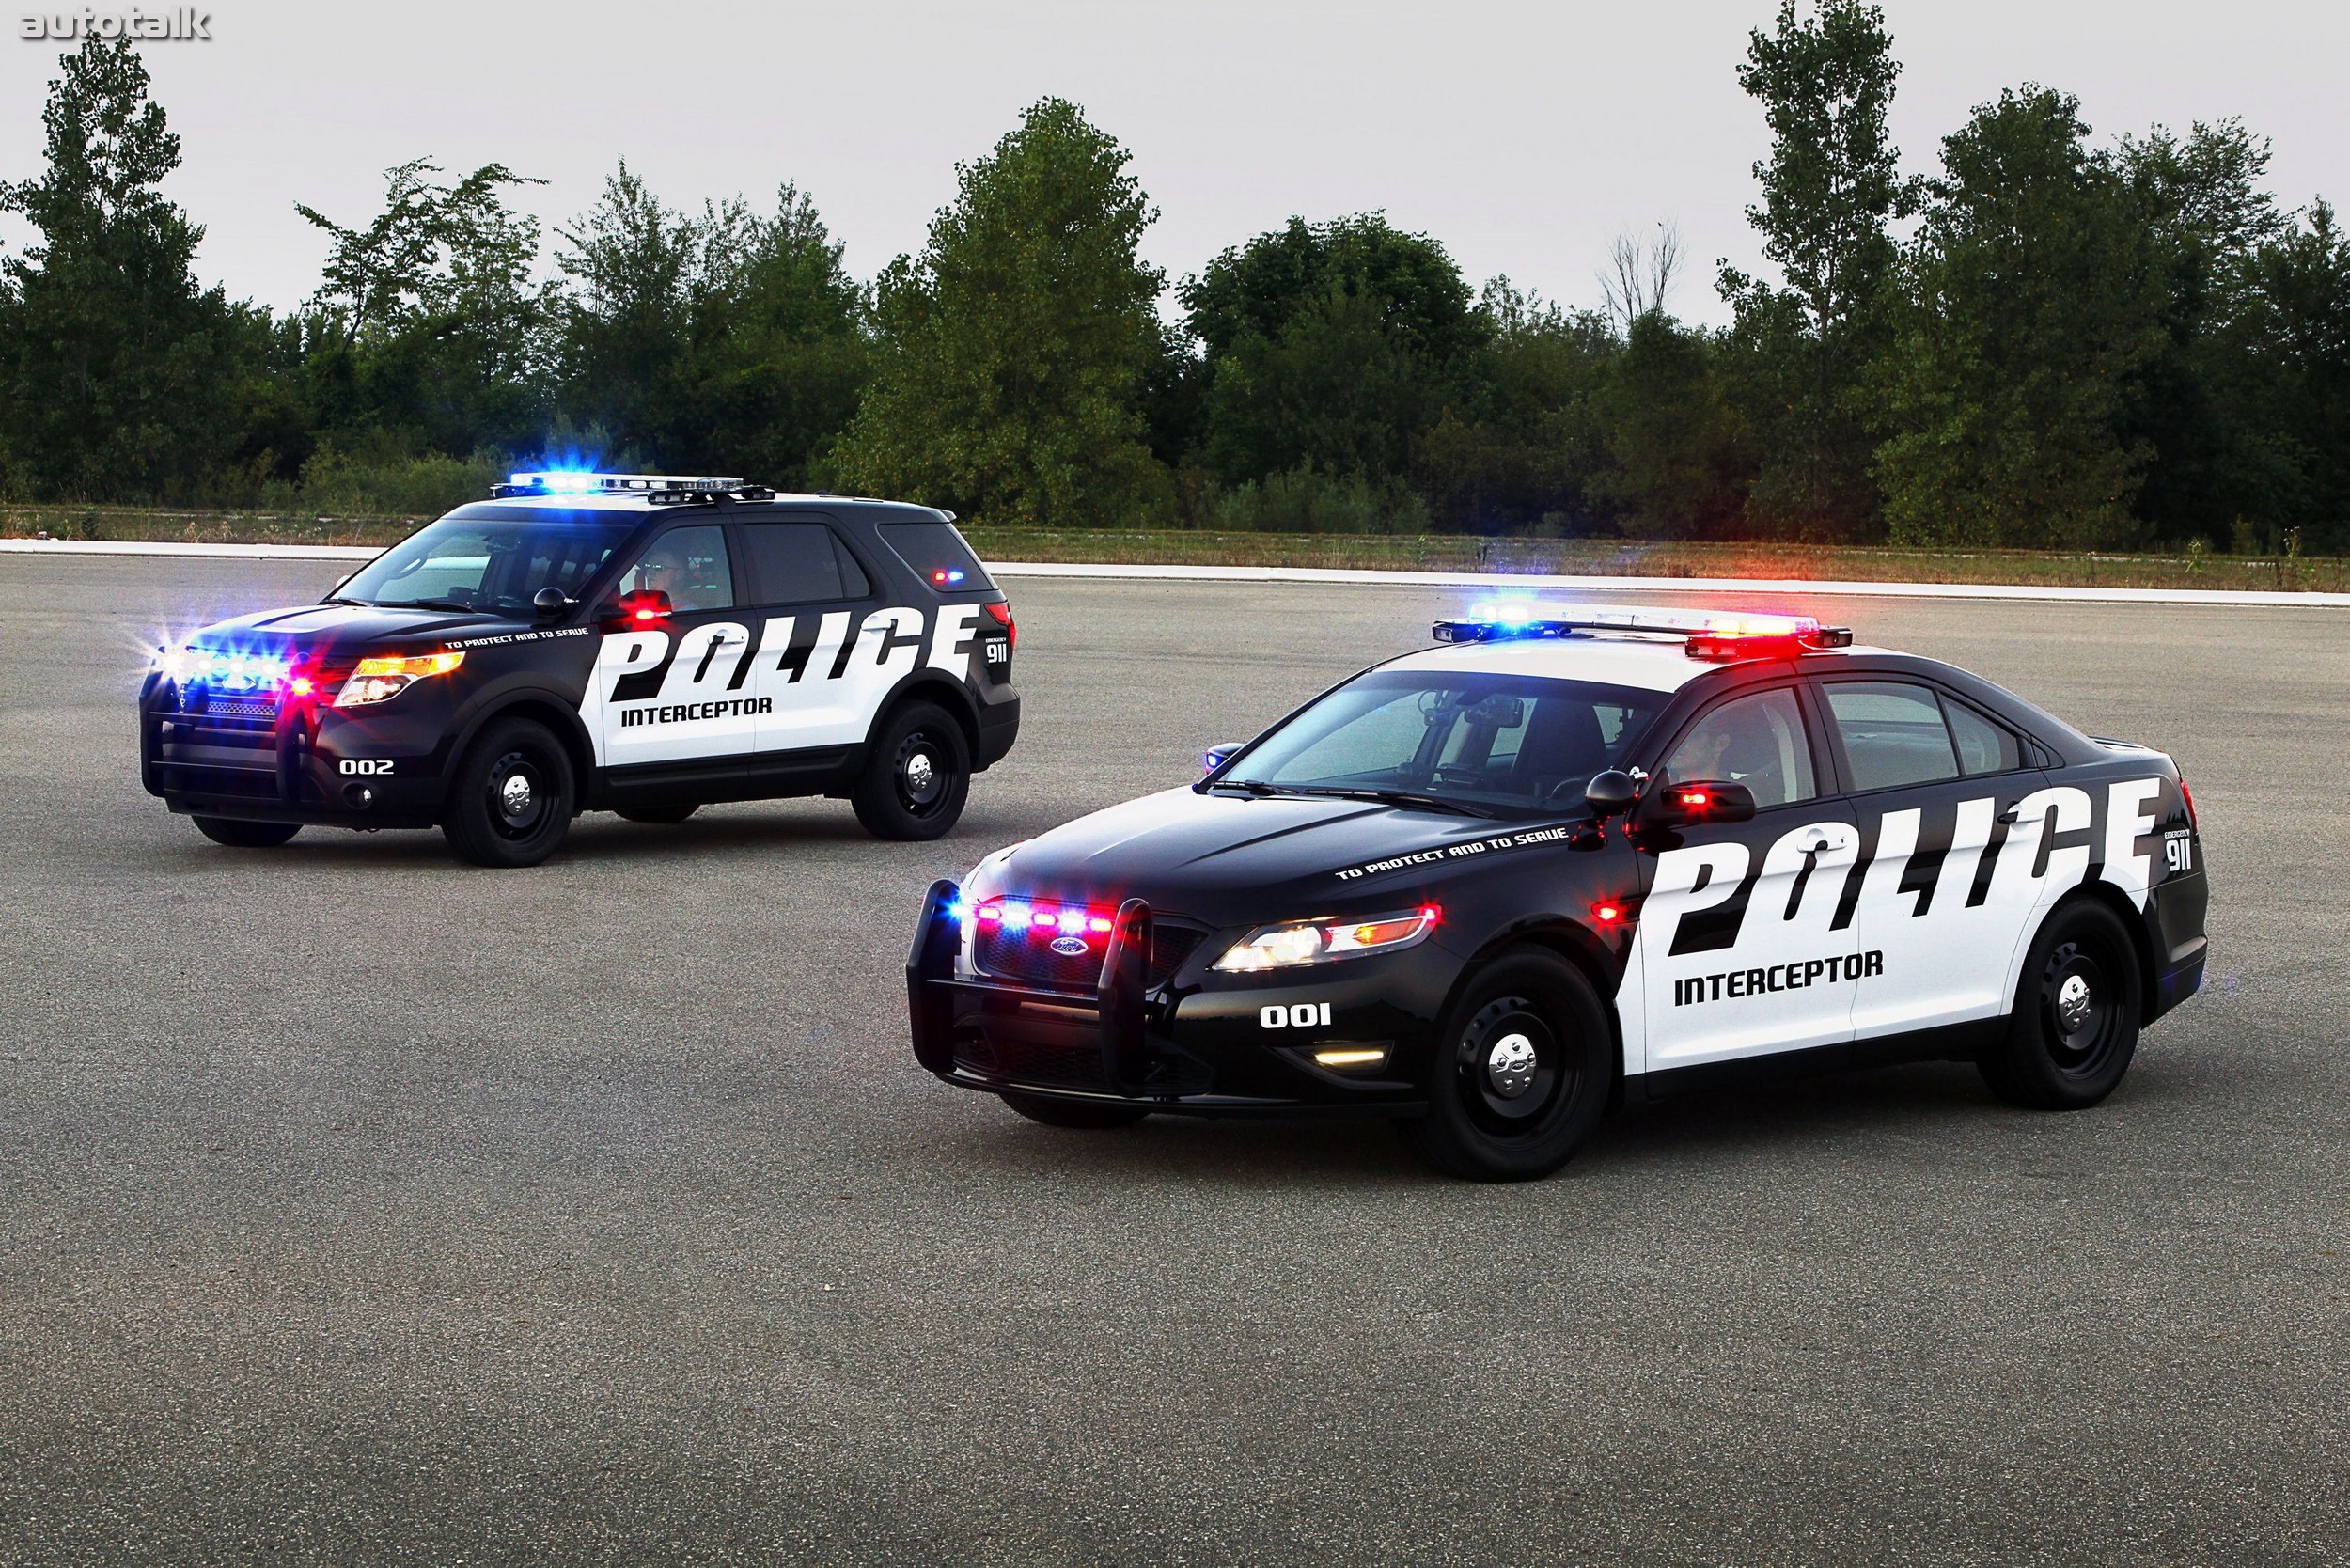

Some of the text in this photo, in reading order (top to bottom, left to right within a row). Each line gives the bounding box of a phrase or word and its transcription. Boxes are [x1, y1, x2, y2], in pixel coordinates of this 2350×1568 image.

[463, 635, 512, 647] PROTECT
[515, 633, 538, 641] AND
[556, 627, 589, 637] SERVE
[581, 604, 980, 702] POLICE
[987, 644, 1007, 664] 911
[621, 697, 773, 727] INTERCEPTOR
[339, 760, 394, 775] 002
[1335, 827, 1569, 881] TO PROTECT AND TO SERVE
[1630, 778, 2160, 956] POLICE
[2166, 839, 2191, 871] 911
[1675, 949, 1883, 1007] INTERCEPTOR
